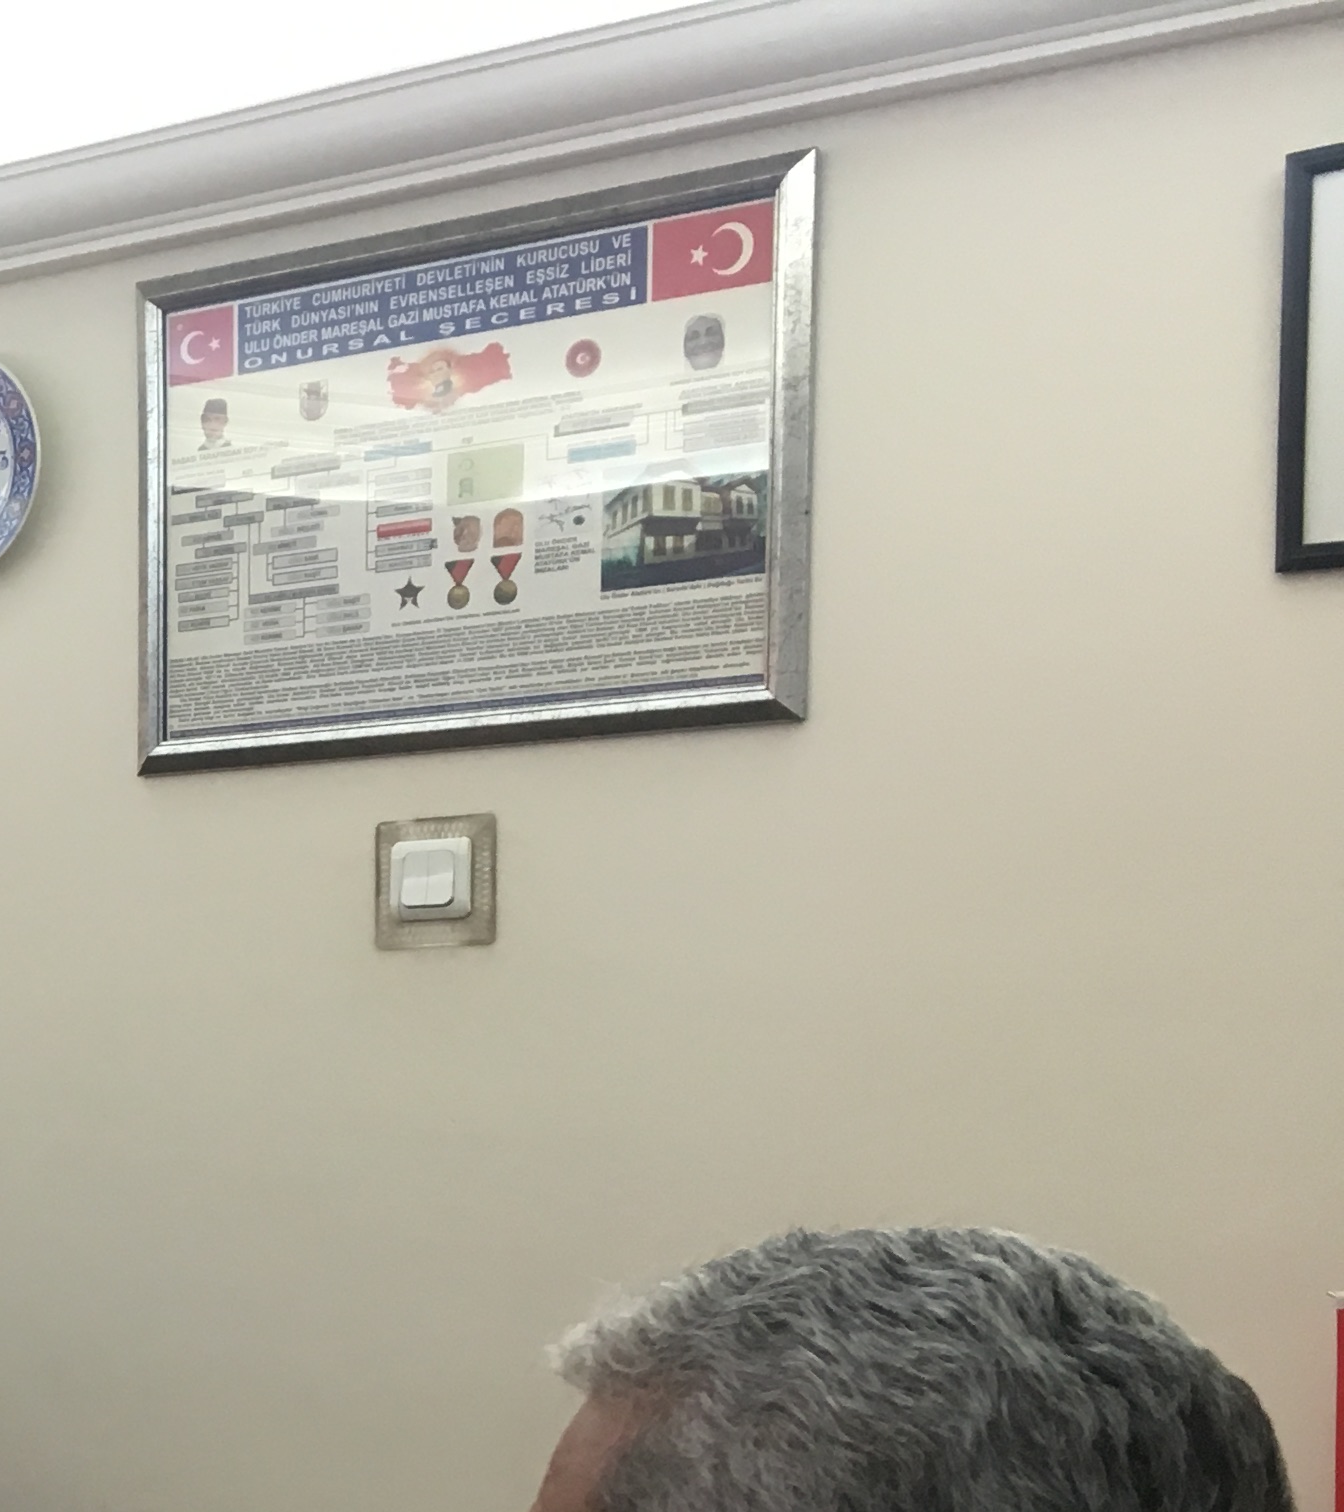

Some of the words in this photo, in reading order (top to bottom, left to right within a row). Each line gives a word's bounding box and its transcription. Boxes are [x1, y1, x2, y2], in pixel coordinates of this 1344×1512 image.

[245, 297, 302, 319] TÜRKİYE
[312, 273, 406, 306] CUMHURİYETİ
[416, 257, 505, 286] DEVLETİ'NİN
[516, 240, 600, 267] KURUCUSU
[612, 233, 632, 249] VE
[245, 318, 282, 336] TÜRK
[291, 300, 379, 329] DÜNYASI'NIN
[389, 274, 514, 310] EVRENSELLEŞEN
[526, 264, 570, 285] EŞSİZ
[581, 250, 632, 275] LİDERİ
[245, 338, 270, 354] ULU
[273, 330, 318, 350] ÖNDER
[321, 318, 384, 341] MAREŞAL
[388, 310, 419, 328] GAZİ
[422, 300, 486, 322] MUSTAFA
[489, 290, 538, 310] KEMAL
[542, 272, 631, 300] ATATÜRK'ÜN
[244, 331, 414, 369] ONURSAL
